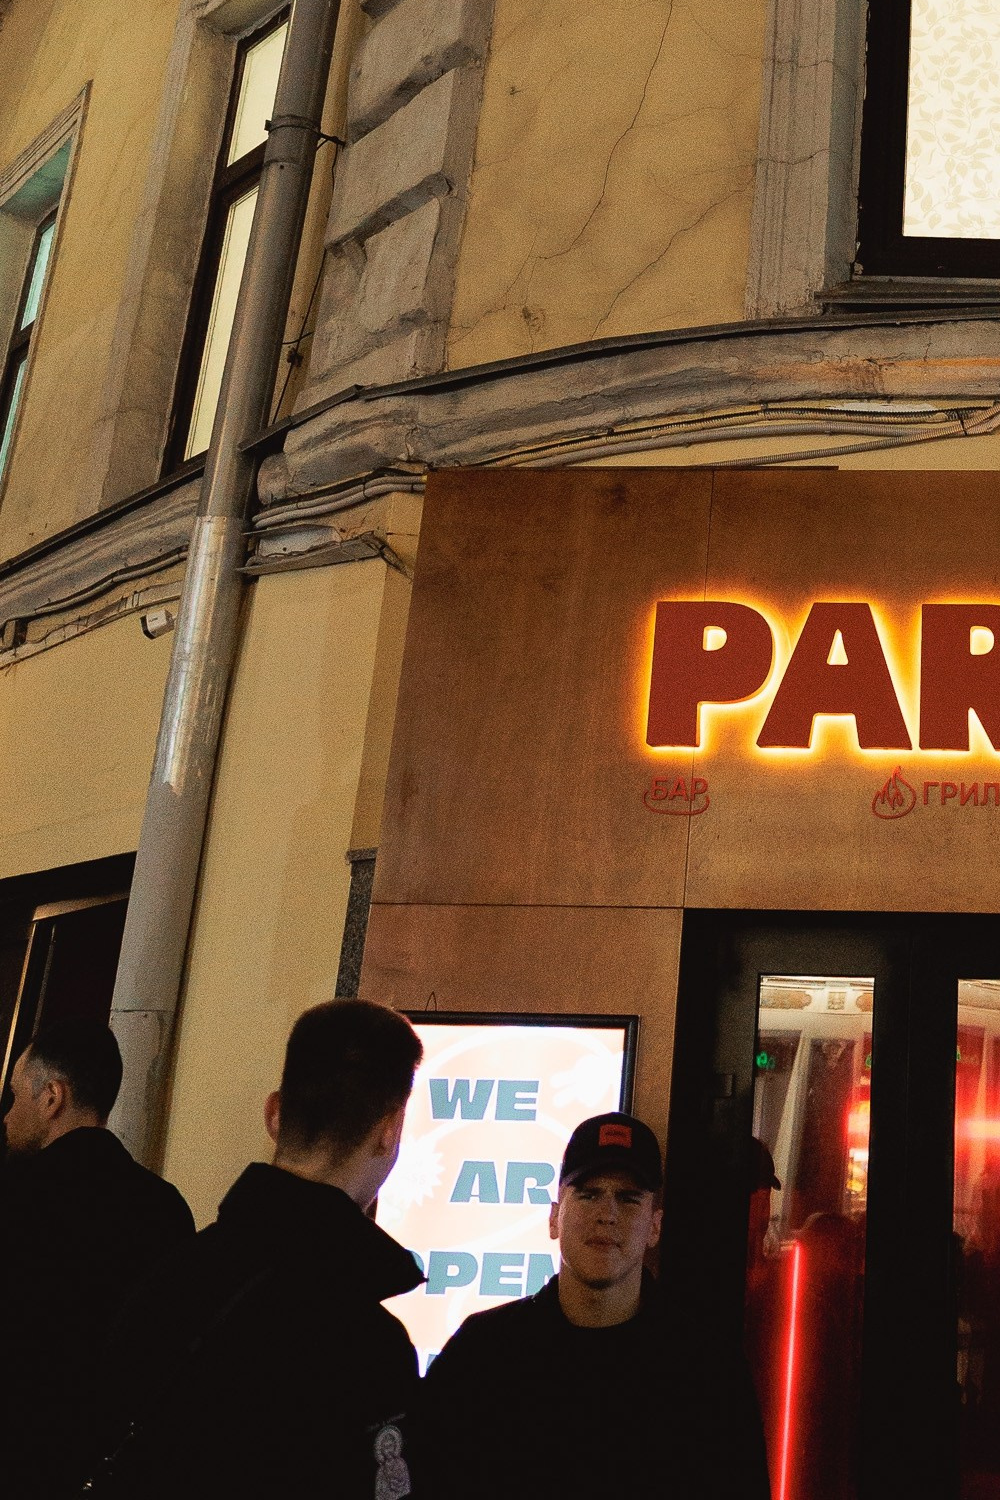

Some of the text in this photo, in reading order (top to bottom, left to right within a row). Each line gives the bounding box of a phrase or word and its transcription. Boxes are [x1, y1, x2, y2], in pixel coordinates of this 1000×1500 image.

[650, 777, 708, 801] БАР
[429, 1078, 540, 1121] WE
[450, 1160, 562, 1205] AR
